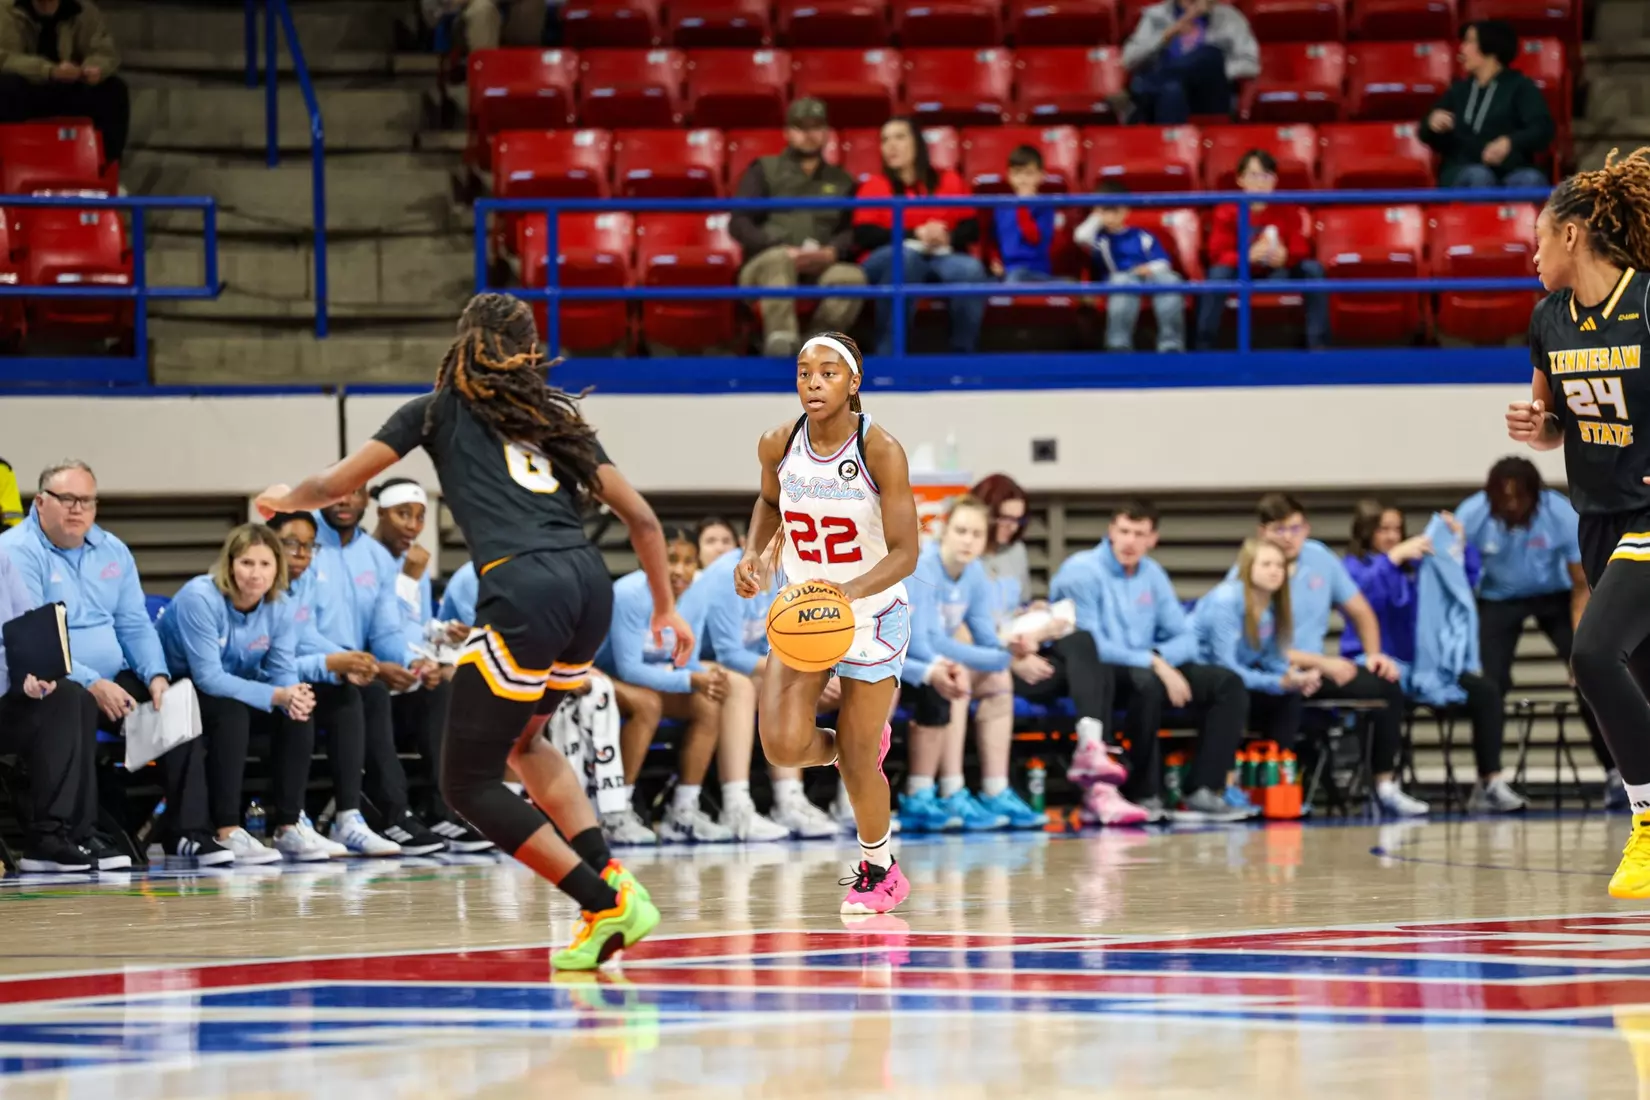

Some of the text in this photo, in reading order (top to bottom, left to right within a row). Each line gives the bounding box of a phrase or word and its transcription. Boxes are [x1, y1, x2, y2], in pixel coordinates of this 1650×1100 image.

[1548, 345, 1641, 375] KENNESAW
[1561, 376, 1629, 421] 24
[1577, 420, 1634, 447] STATE
[784, 510, 863, 564] 22
[783, 585, 843, 602] Wilson
[798, 607, 841, 623] NCAA
